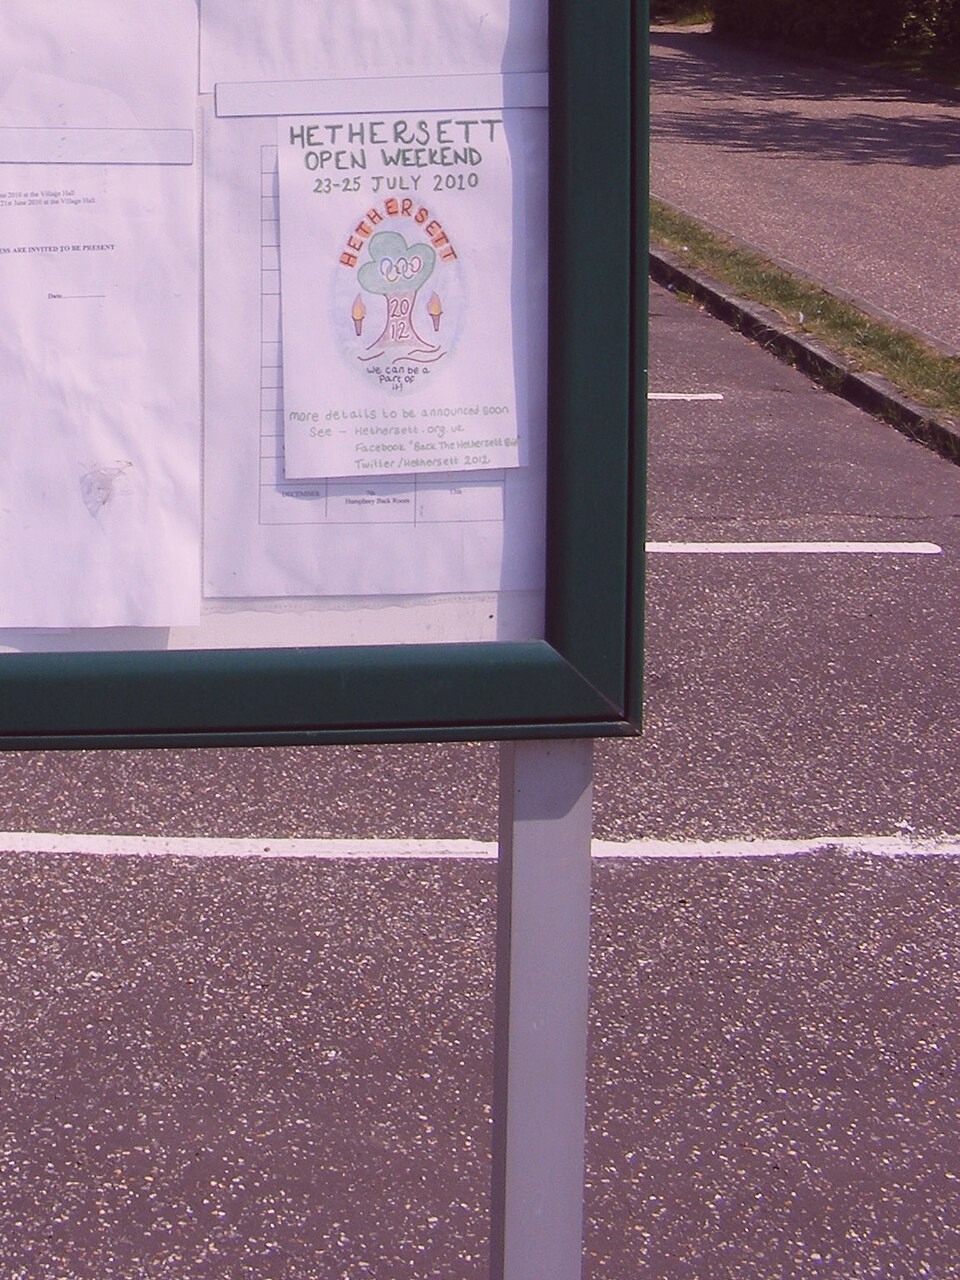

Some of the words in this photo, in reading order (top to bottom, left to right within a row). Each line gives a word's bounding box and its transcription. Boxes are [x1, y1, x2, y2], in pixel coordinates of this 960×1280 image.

[290, 119, 503, 148] HETHERSETT
[305, 150, 366, 171] OPEN
[381, 148, 482, 167] WEEKEND
[313, 176, 361, 193] 23-25
[372, 176, 420, 192] JULY
[433, 173, 479, 191] 2010
[340, 198, 458, 268] HETHERSETT
[390, 298, 409, 317] 20
[390, 321, 409, 340] 12
[386, 366, 405, 375] can
[407, 366, 419, 375] be
[326, 409, 376, 420] details
[383, 409, 396, 419] to
[402, 409, 415, 418] be
